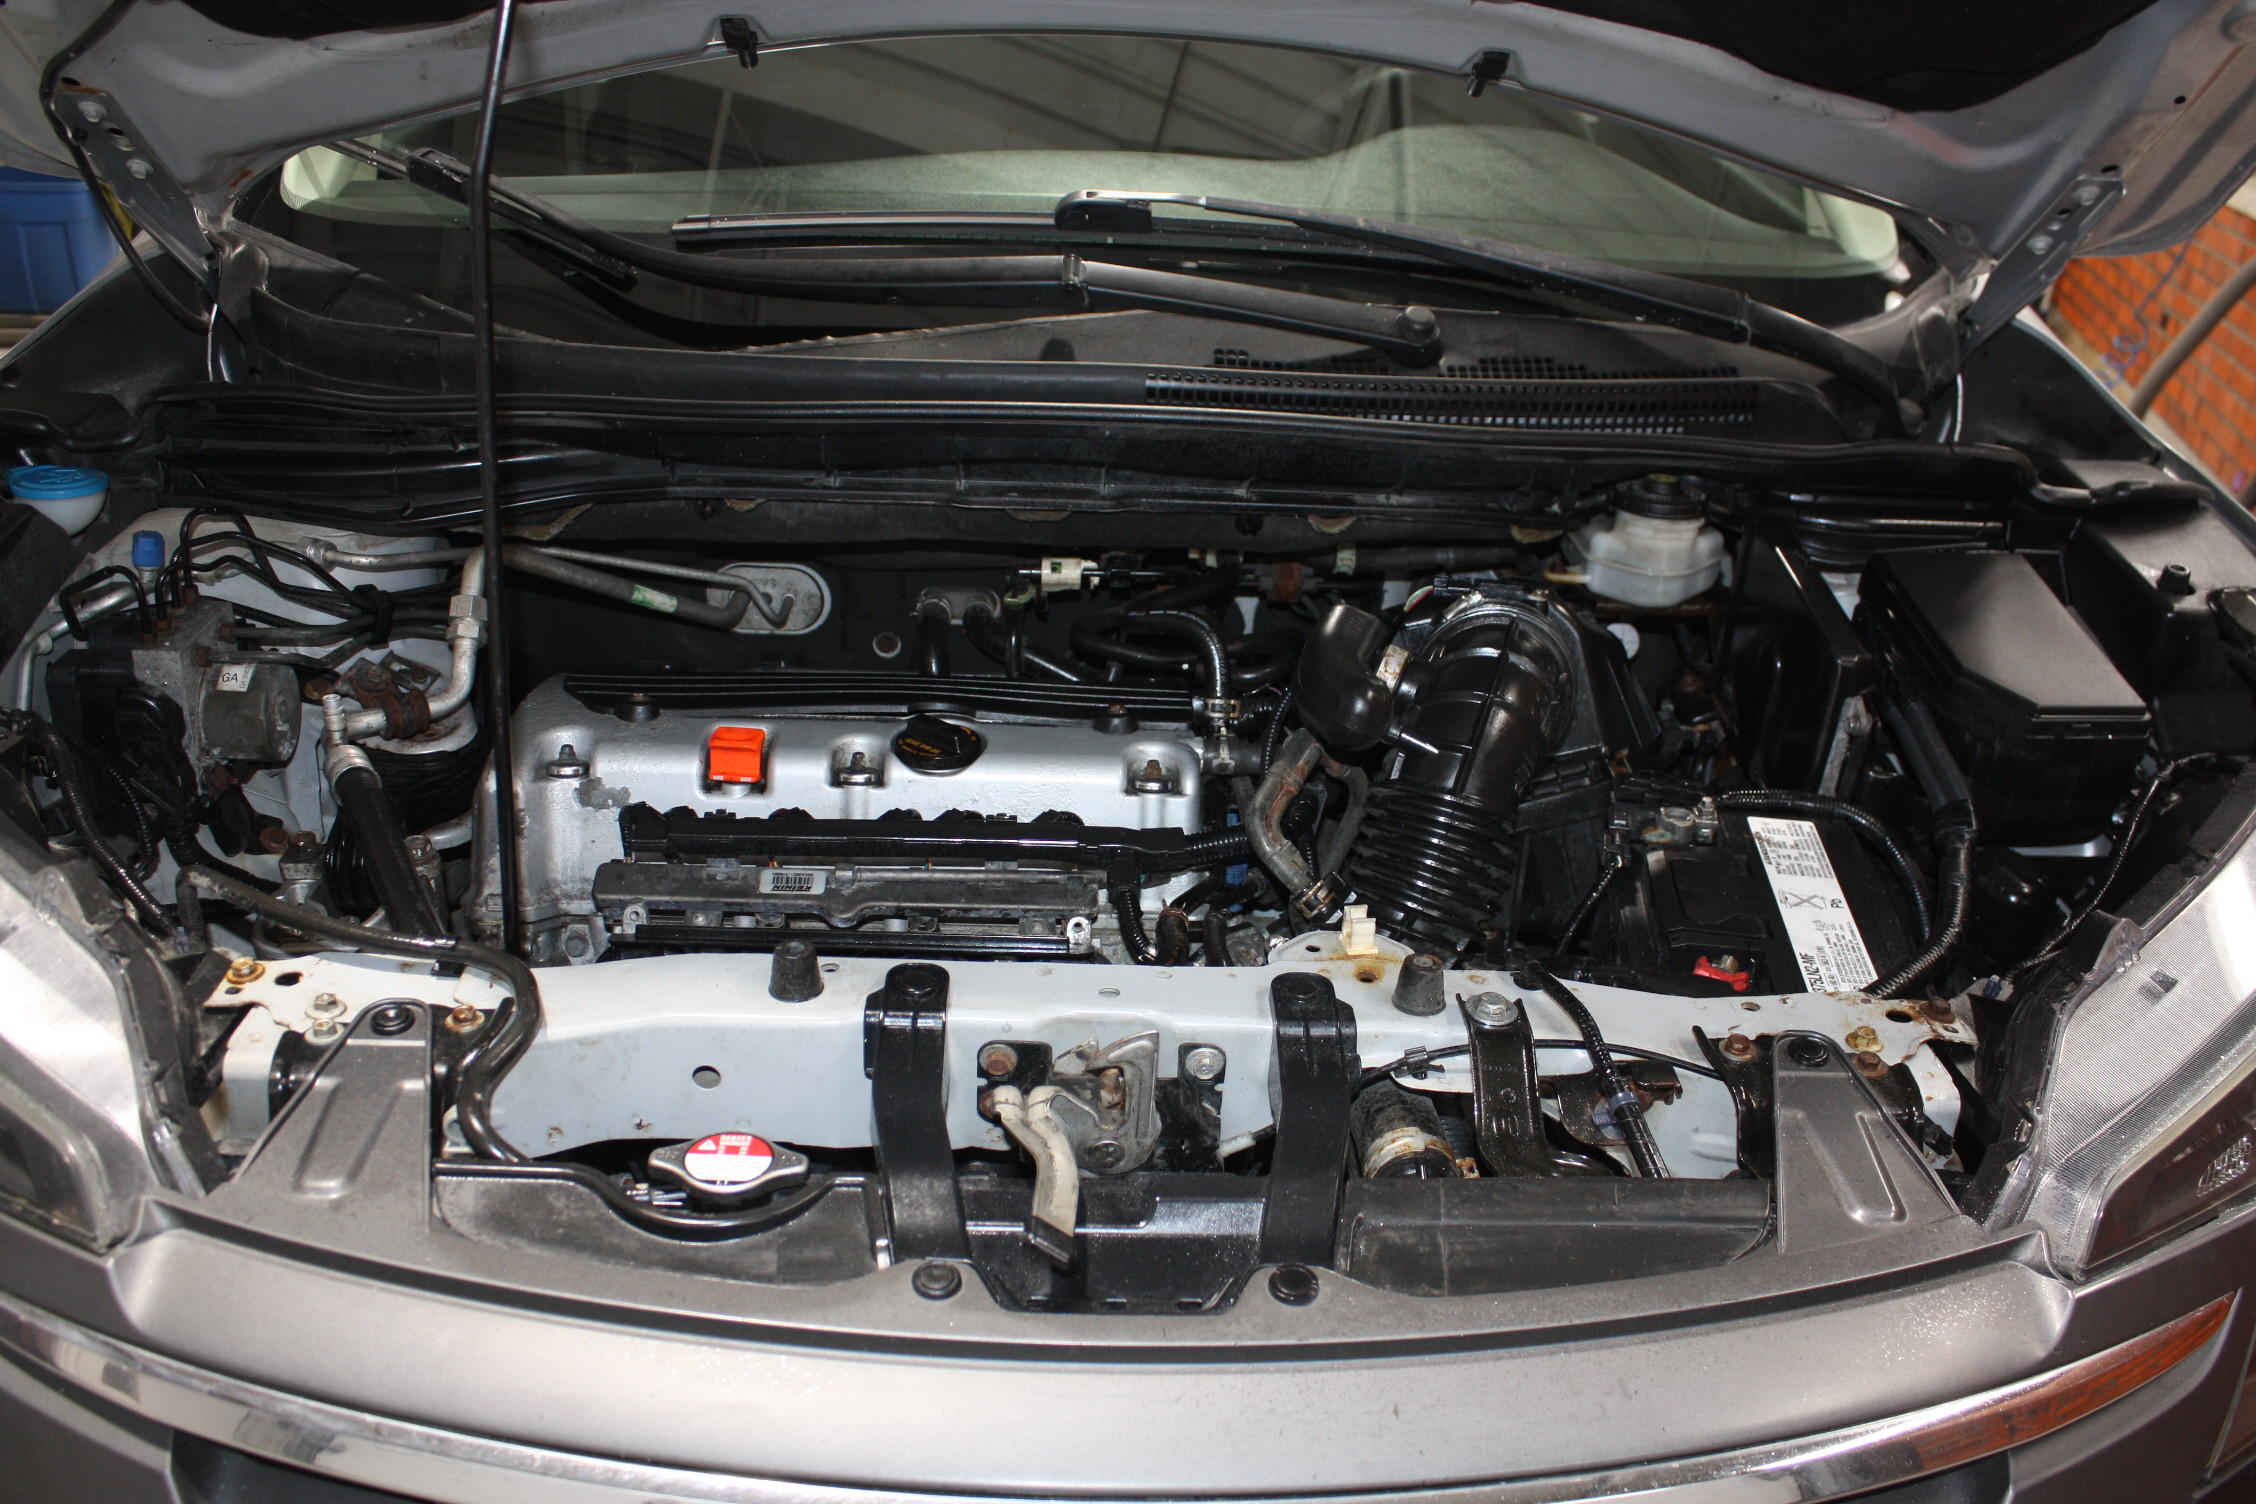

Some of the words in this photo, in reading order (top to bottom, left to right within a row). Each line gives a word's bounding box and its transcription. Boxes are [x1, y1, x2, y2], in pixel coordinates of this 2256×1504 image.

[222, 673, 238, 682] GA
[771, 885, 812, 893] KEIHIN
[1830, 899, 1843, 909] Pb
